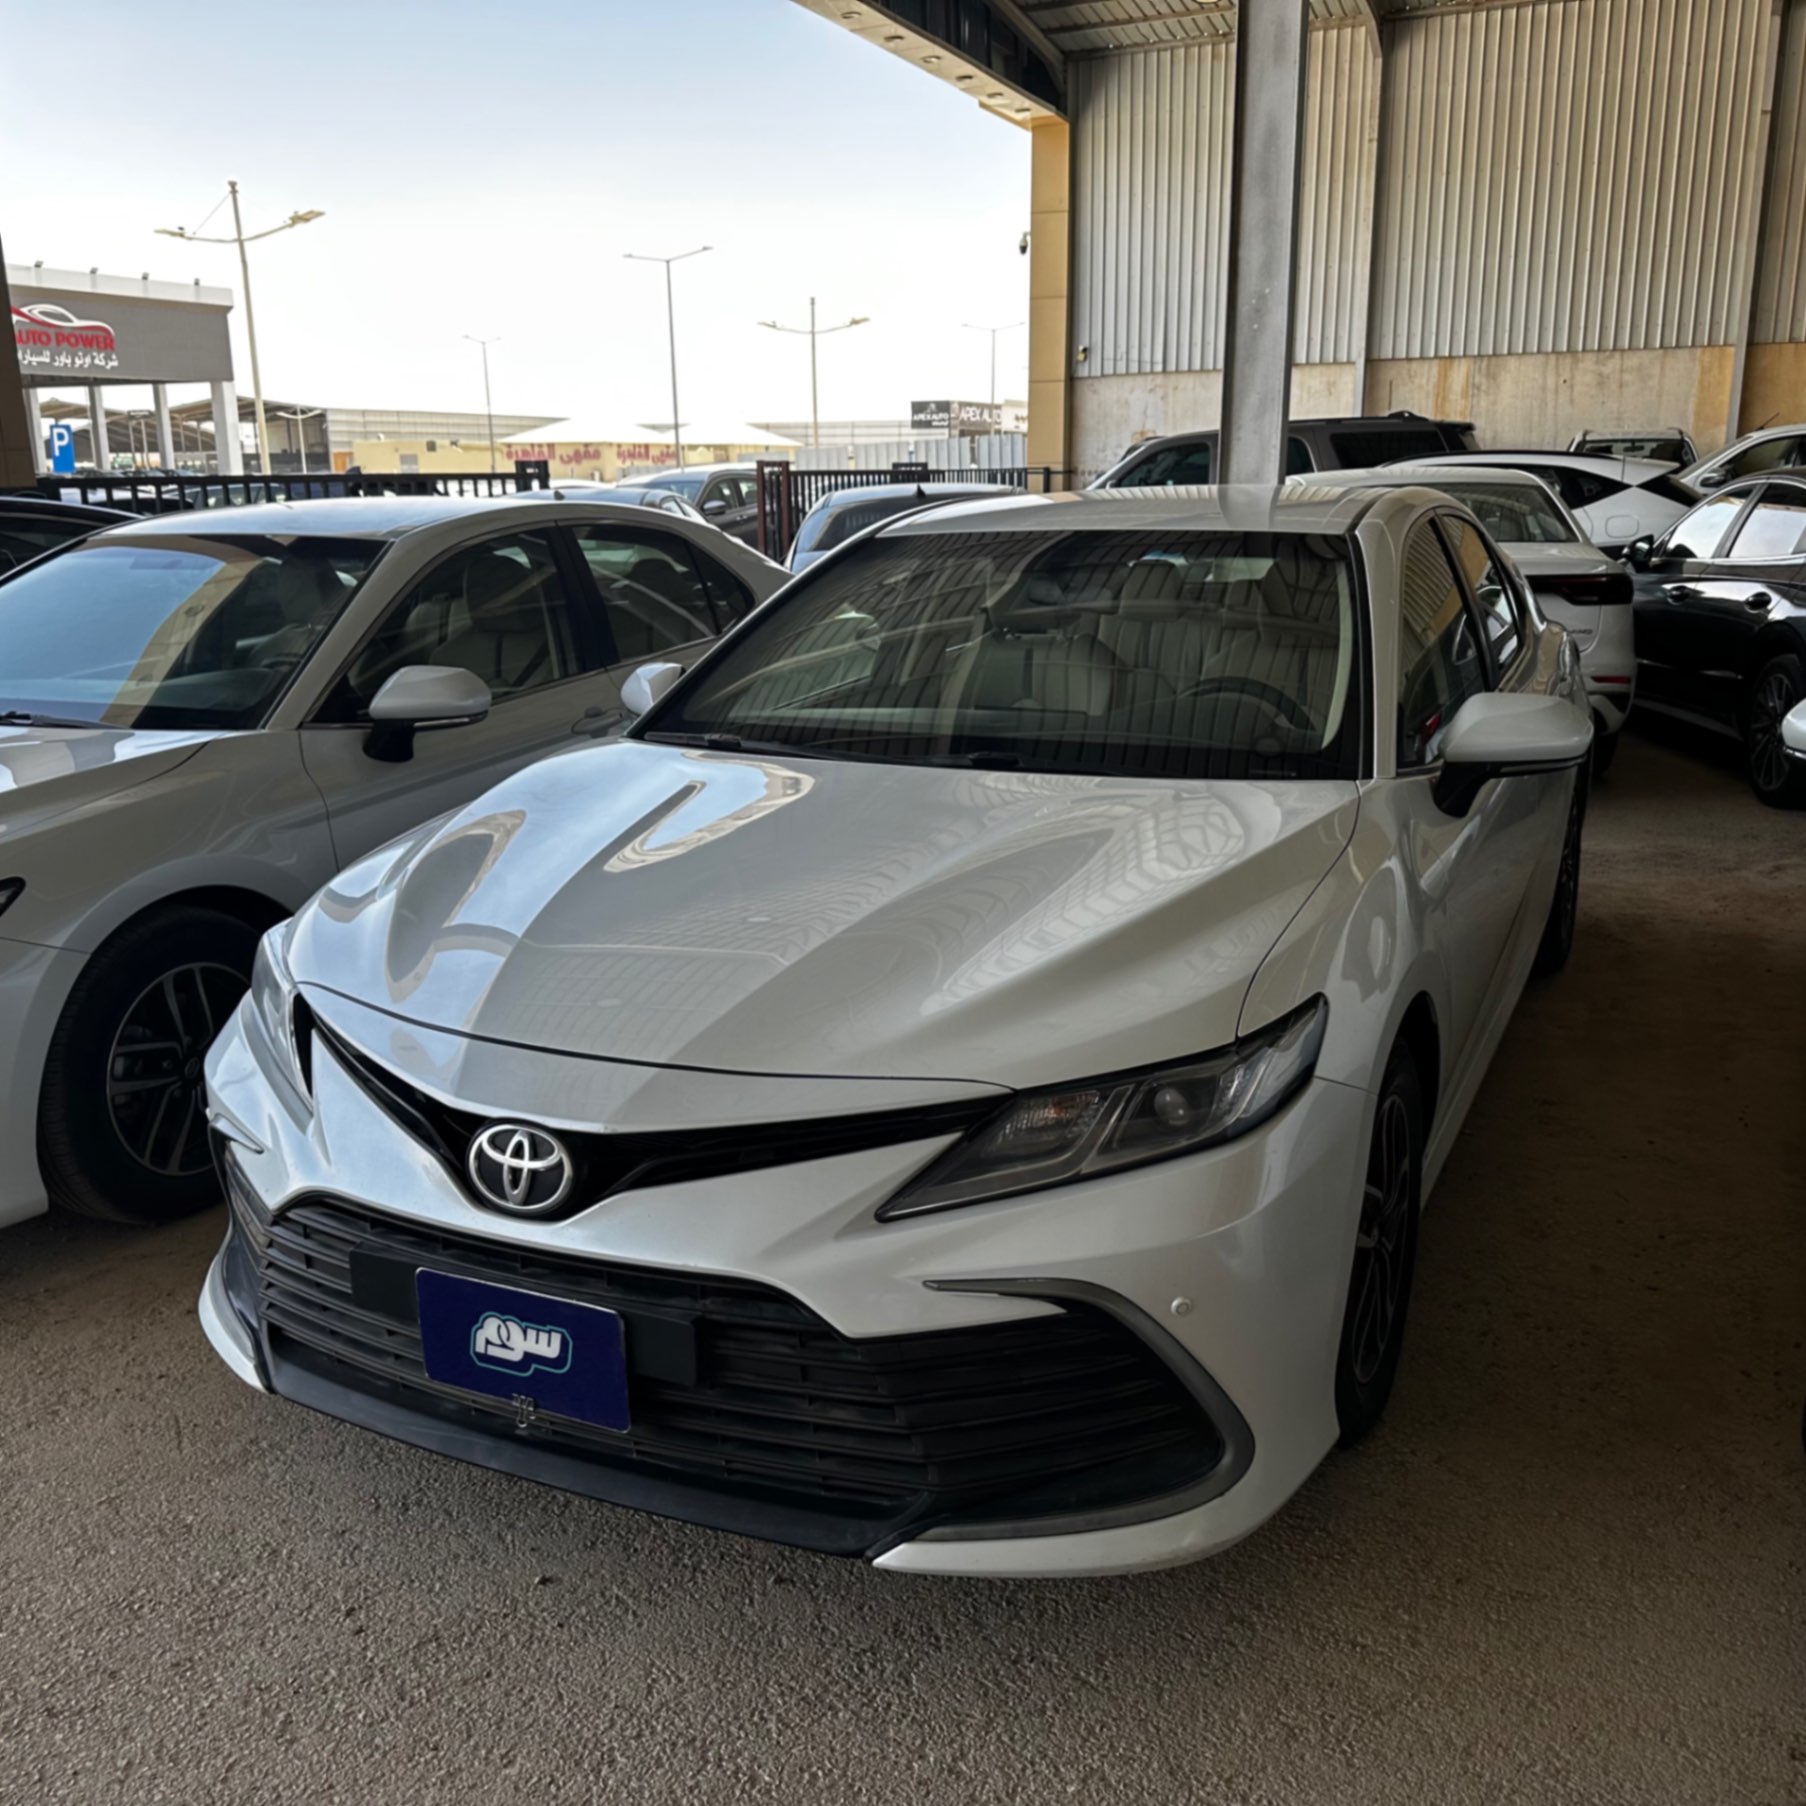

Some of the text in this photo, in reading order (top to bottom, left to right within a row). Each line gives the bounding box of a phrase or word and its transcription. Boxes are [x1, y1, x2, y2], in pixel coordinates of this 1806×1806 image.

[55, 331, 115, 351] POWER
[93, 351, 119, 369] شركة
[959, 406, 981, 421] APEX
[52, 427, 70, 457] P
[505, 443, 557, 461] القاهرة
